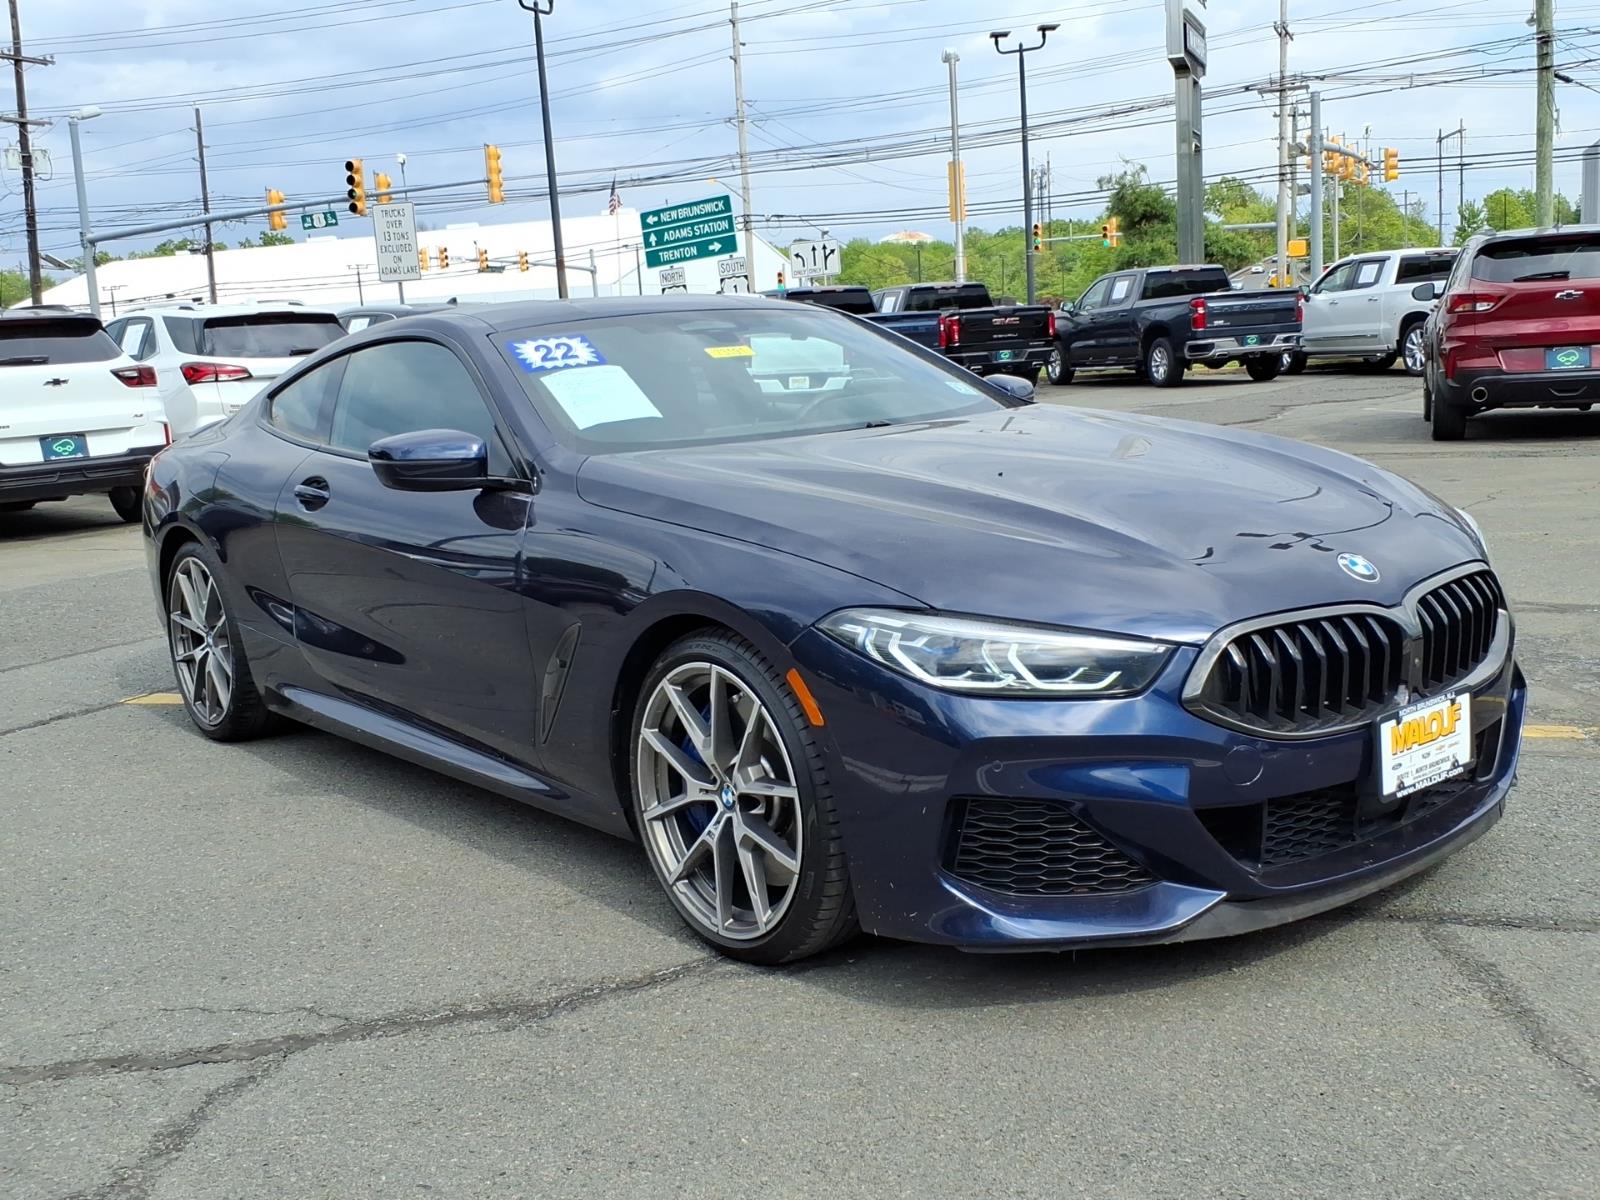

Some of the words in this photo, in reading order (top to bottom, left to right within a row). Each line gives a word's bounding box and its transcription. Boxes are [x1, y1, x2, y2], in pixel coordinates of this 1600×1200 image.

[381, 208, 406, 219] TRUCKS
[660, 209, 678, 223] NEW
[677, 200, 725, 219] BRUNSWICK
[386, 220, 403, 230] OVER
[663, 226, 693, 242] ADAMS
[693, 219, 729, 236] STATION
[383, 231, 392, 242] 13
[393, 231, 410, 241] TONS
[380, 243, 413, 254] EXCLUDED
[658, 245, 698, 263] TRENTON
[393, 255, 402, 264] ON
[381, 266, 401, 275] ADAMS
[402, 265, 419, 275] LANE
[720, 261, 745, 276] SOUTH
[661, 271, 684, 285] NORTH
[534, 342, 580, 363] 22
[1391, 703, 1461, 756] MALOUF
[1396, 766, 1464, 798] www.MALOUF.com
